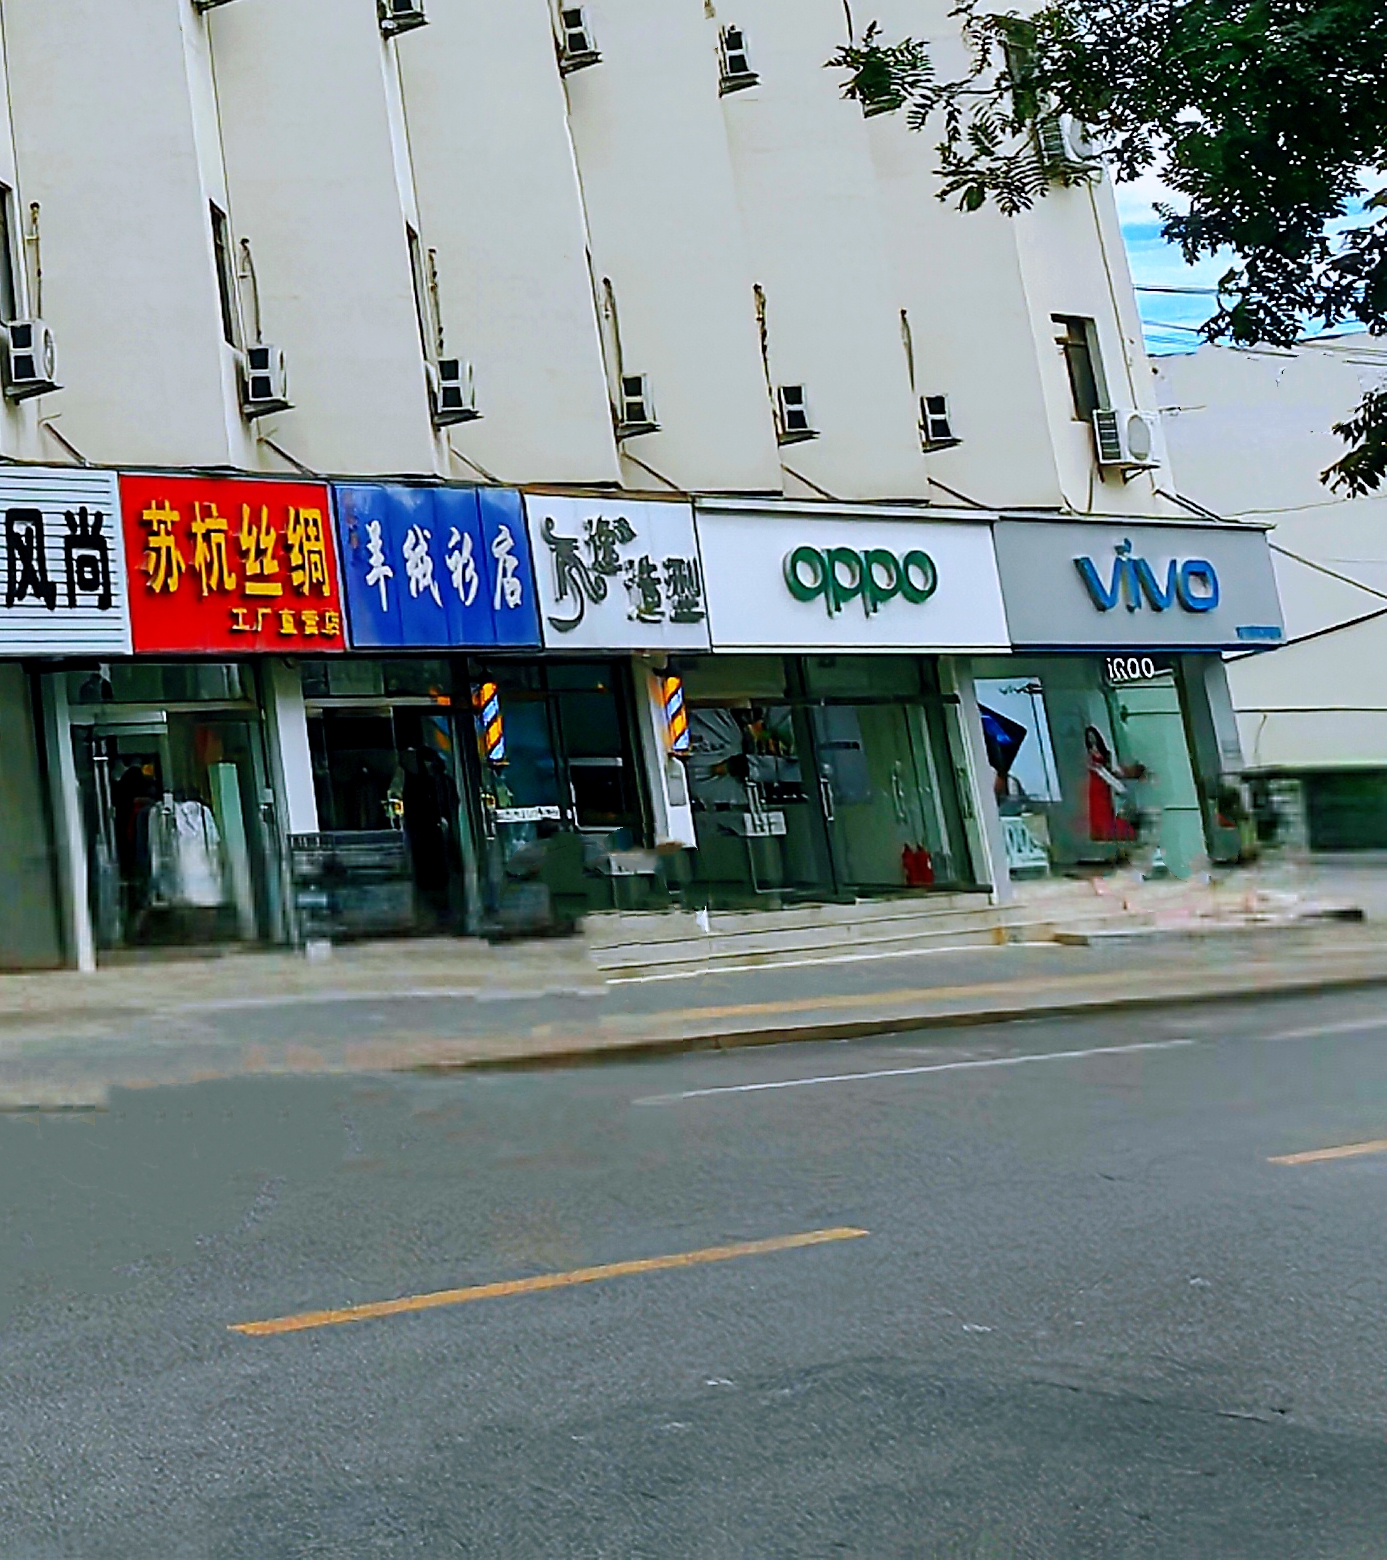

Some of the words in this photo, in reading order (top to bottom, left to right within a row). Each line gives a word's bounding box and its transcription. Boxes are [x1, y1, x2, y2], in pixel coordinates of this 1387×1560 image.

[142, 500, 331, 596] 苏杭丝绸
[1073, 538, 1220, 612] vivo
[231, 608, 340, 635] 工厂直营店
